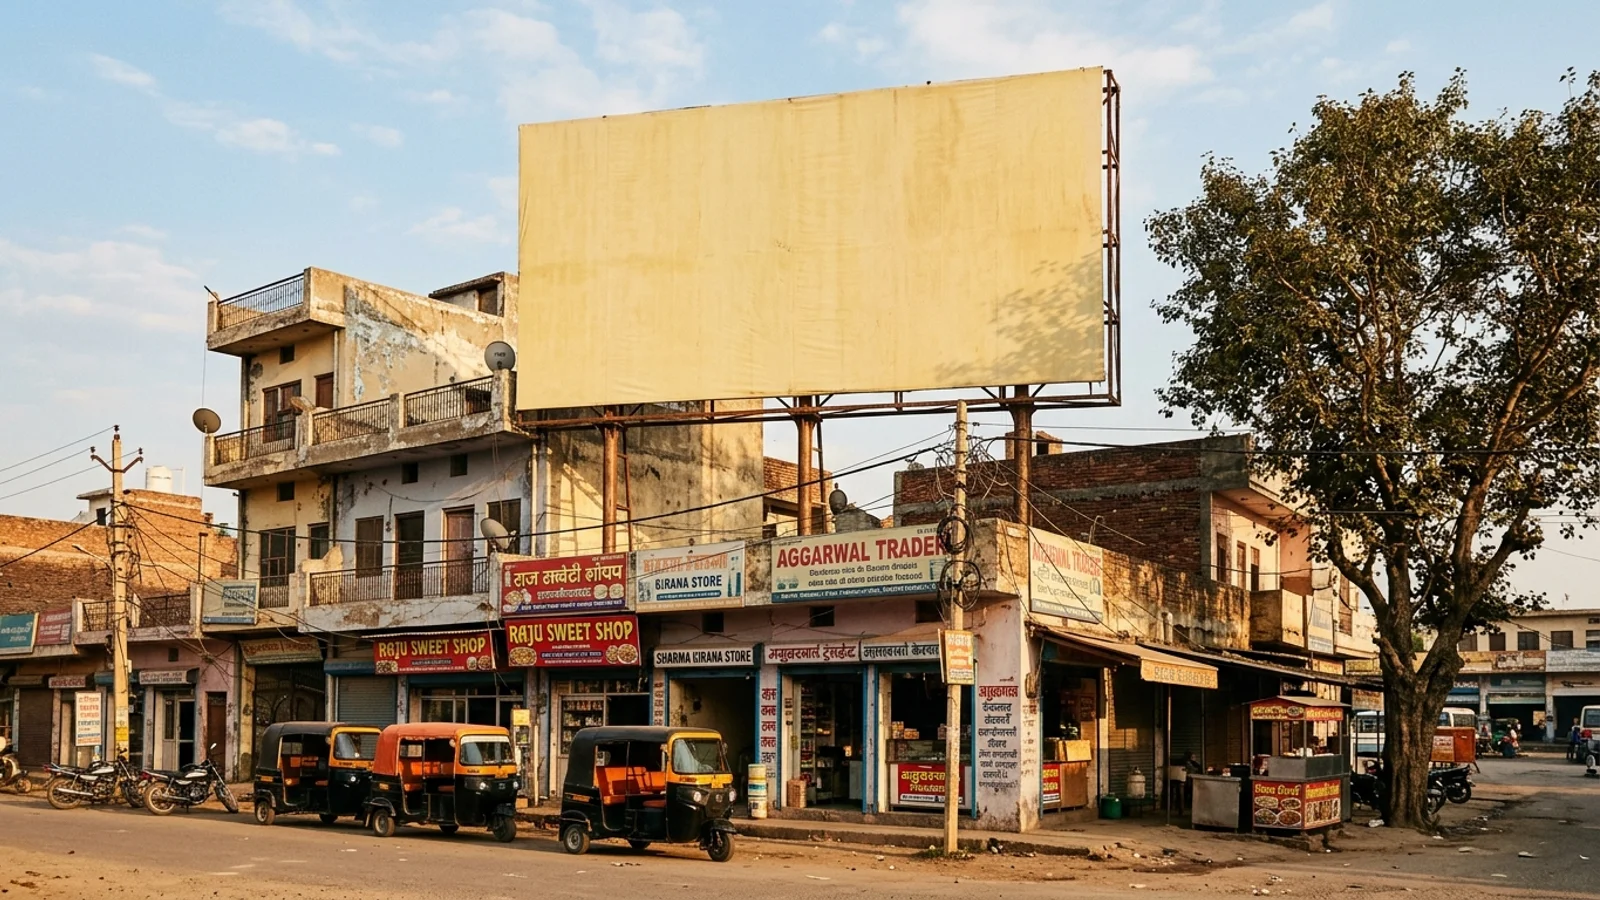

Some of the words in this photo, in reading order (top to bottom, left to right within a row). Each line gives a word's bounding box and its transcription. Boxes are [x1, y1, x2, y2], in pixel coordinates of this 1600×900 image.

[776, 541, 871, 568] AGGARWAL
[691, 575, 722, 588] STORE
[508, 624, 543, 647] RAJU
[546, 622, 591, 642] SWEET
[595, 620, 633, 641] SHOP
[411, 639, 450, 656] SWEET
[452, 637, 486, 655] SHOP
[656, 652, 691, 664] SHARMA
[724, 650, 752, 662] STORE
